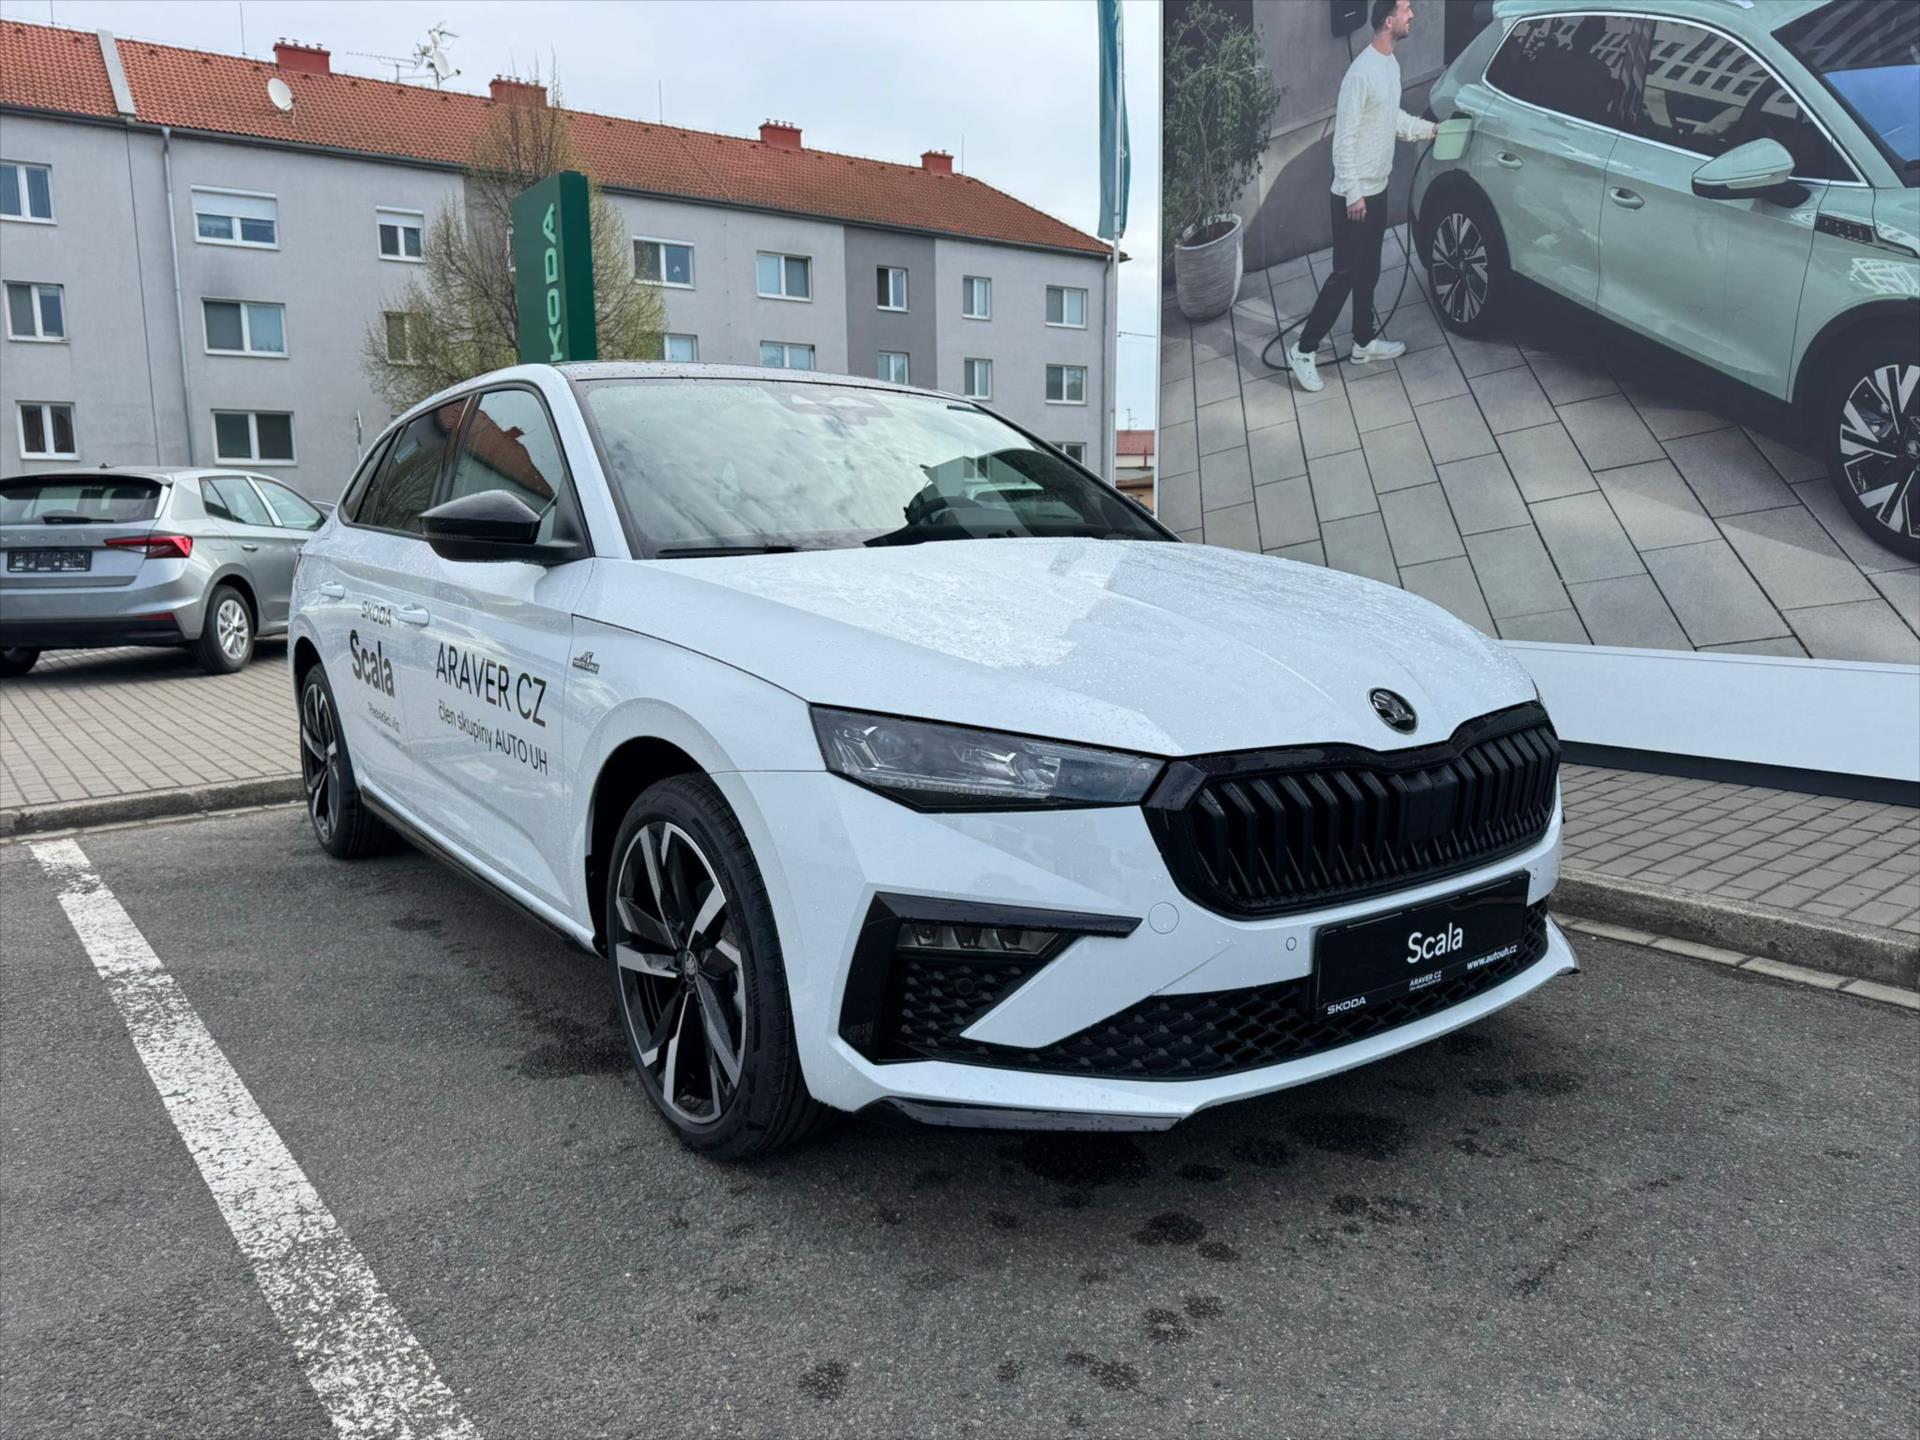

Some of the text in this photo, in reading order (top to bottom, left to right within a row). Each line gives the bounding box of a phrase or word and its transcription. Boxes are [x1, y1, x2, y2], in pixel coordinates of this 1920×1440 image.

[542, 202, 563, 362] KODA
[350, 629, 395, 699] Scala
[436, 641, 547, 728] ARAVER CZ
[438, 698, 457, 726] člen
[457, 710, 492, 752] skupiny
[495, 728, 528, 763] AUTO
[530, 744, 548, 776] UH
[1406, 922, 1464, 964] Scala
[1409, 973, 1434, 987] ARAVER
[1434, 970, 1442, 979] CZ
